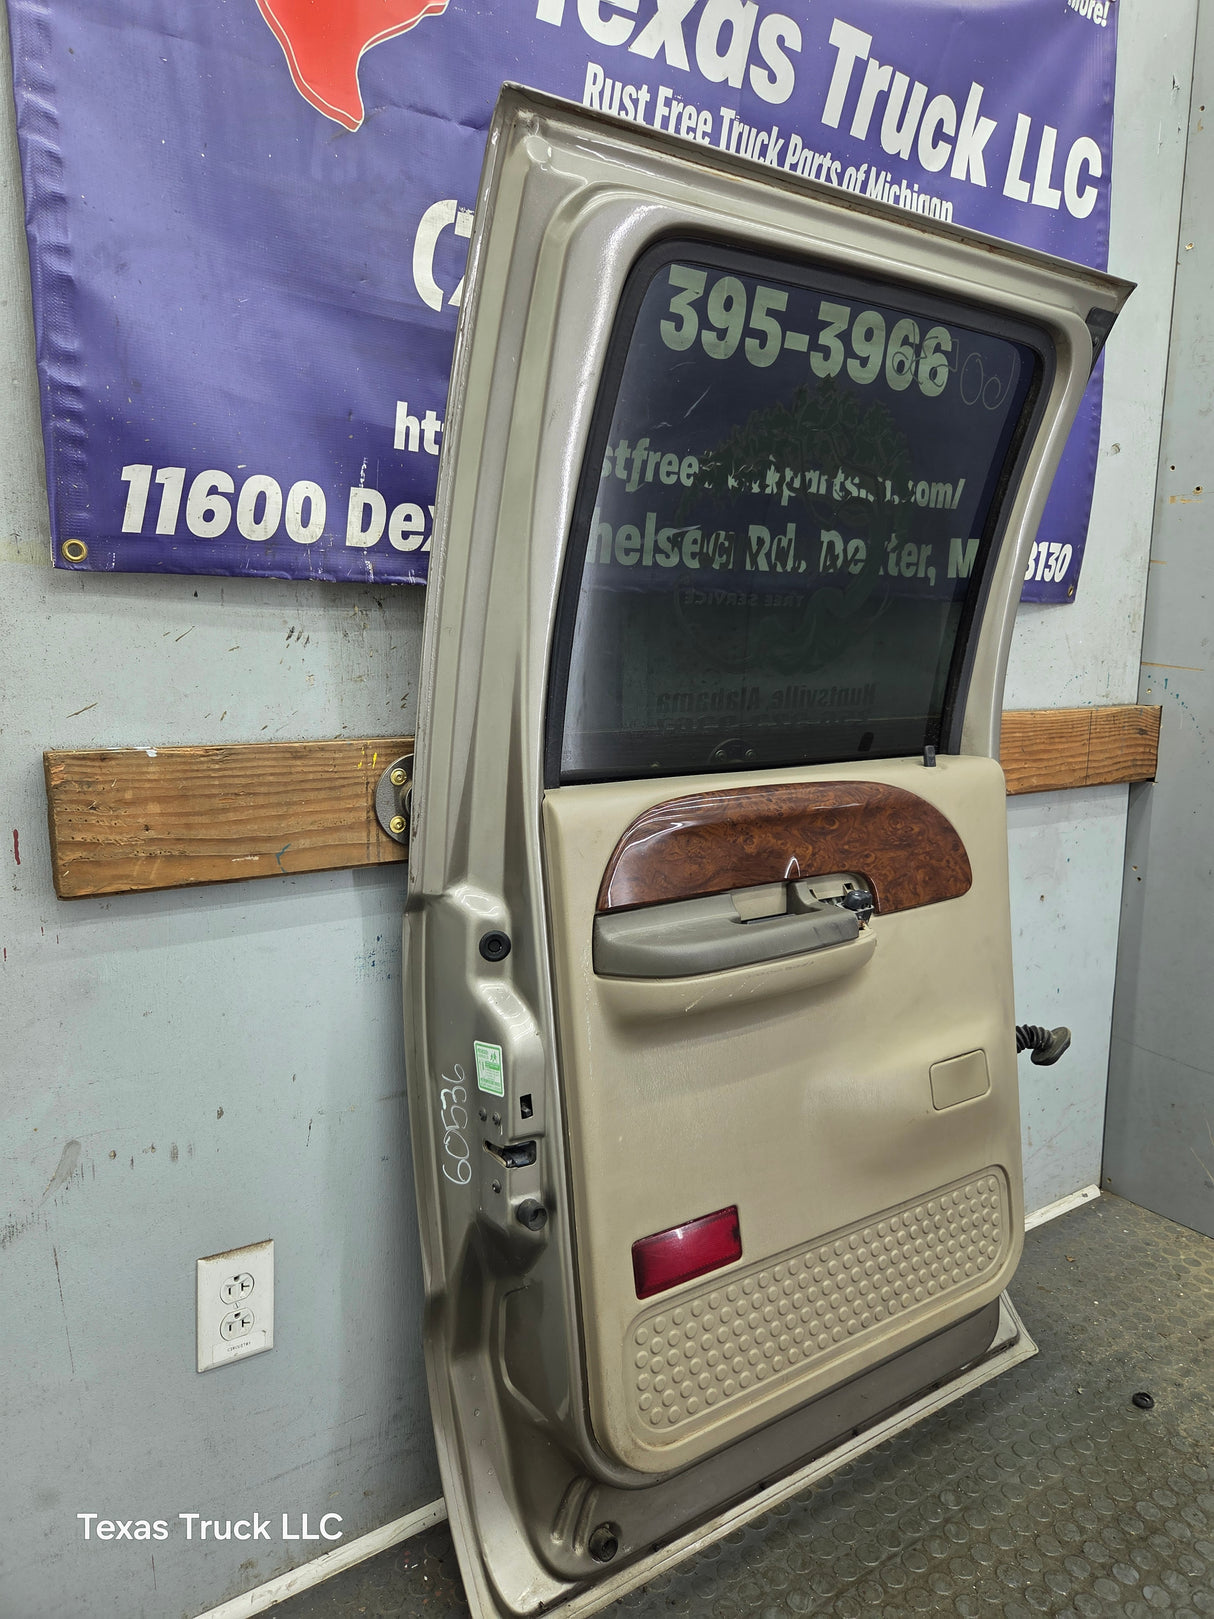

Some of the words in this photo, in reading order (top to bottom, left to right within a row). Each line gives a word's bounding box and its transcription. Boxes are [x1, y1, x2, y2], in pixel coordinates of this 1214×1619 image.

[535, 0, 802, 104] exas
[821, 19, 998, 187] Truck
[1002, 112, 1103, 219] LLC
[583, 61, 651, 126] Rust
[653, 85, 713, 145] Free
[719, 106, 785, 168] Truck
[784, 133, 842, 187] Parts
[842, 163, 868, 196] of
[659, 264, 953, 397] 395-3966
[394, 400, 445, 456] ht
[120, 463, 327, 544] 11600
[819, 529, 937, 587] Deter,
[440, 1063, 472, 1185] 60536
